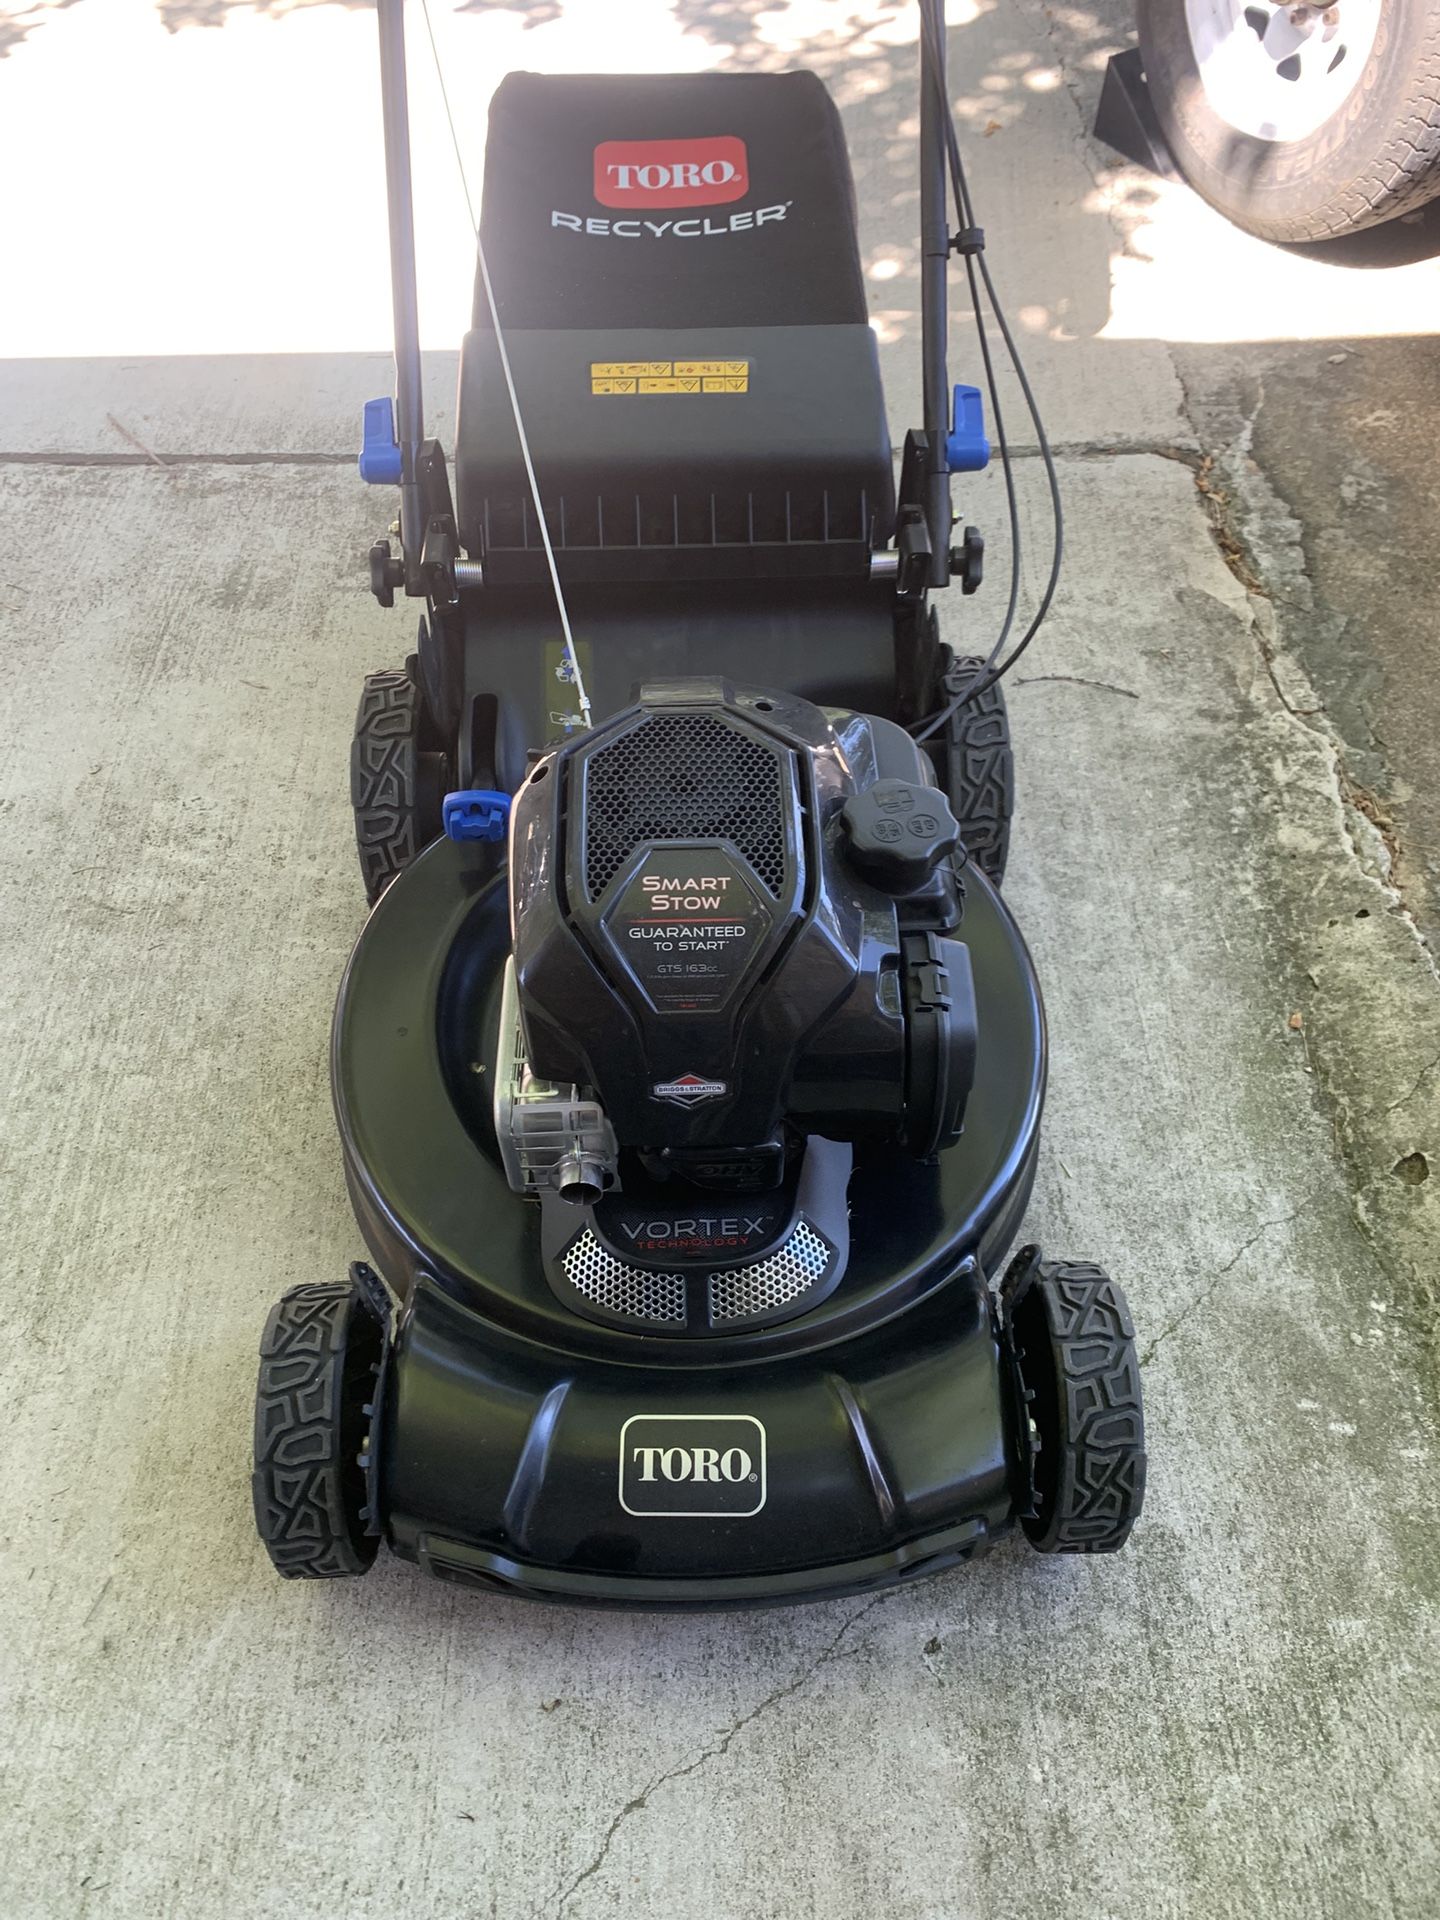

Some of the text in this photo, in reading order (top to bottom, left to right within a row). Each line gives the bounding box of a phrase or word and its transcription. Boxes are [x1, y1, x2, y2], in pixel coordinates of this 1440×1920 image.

[551, 203, 788, 238] RECYCLER
[642, 875, 731, 892] SMART
[651, 895, 721, 911] STOW
[628, 926, 746, 939] GUARANTEED
[653, 941, 673, 952] TO
[657, 963, 718, 974] GTS 163cc
[620, 1216, 766, 1240] VORTEX
[637, 1237, 749, 1249] TECHNOLOGY
